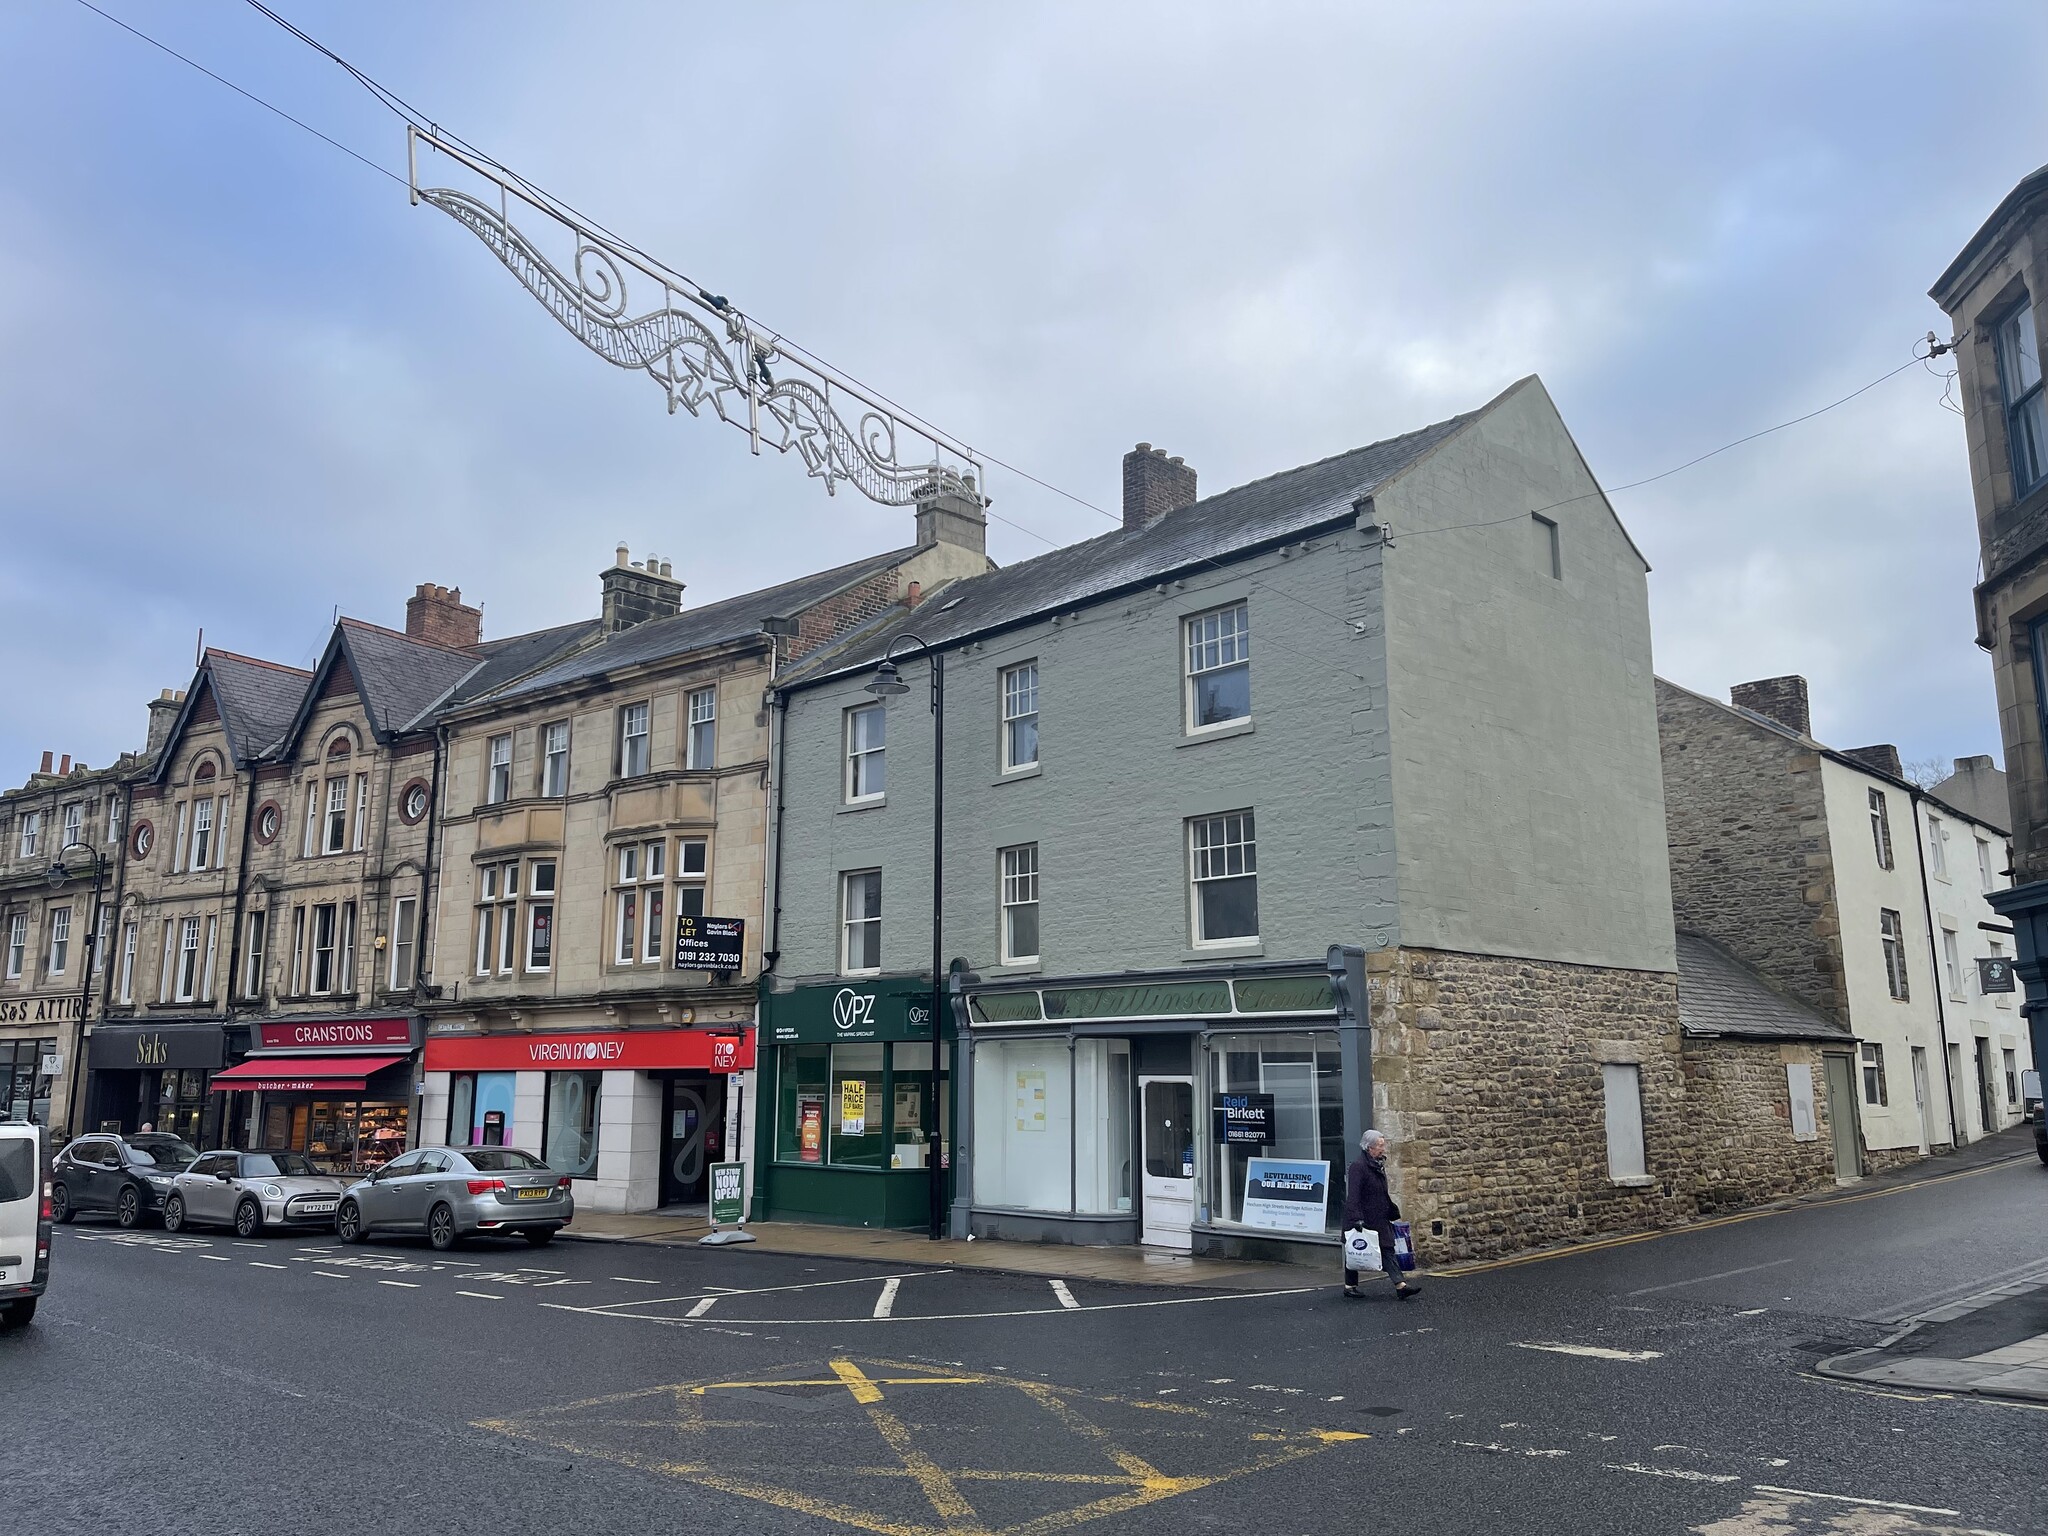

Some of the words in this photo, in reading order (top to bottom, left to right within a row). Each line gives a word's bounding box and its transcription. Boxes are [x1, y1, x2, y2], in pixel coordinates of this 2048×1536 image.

[681, 918, 693, 926] TO
[681, 928, 697, 936] LET
[679, 938, 709, 948] Offices
[678, 951, 696, 961] 0191
[699, 952, 716, 962] 232
[718, 953, 740, 963] 7030
[35, 998, 93, 1020] ATTIRE
[833, 988, 876, 1029] VPZ
[909, 1007, 929, 1023] VPZ
[295, 1025, 373, 1042] CRANSTONS
[136, 1033, 168, 1064] Saks
[529, 1043, 572, 1061] VIRGIN
[573, 1041, 625, 1060] MONEY
[714, 1055, 737, 1067] NEY
[844, 1084, 864, 1094] HALF
[843, 1094, 864, 1103] PRICE
[1224, 1096, 1248, 1107] Reid
[1228, 1108, 1265, 1119] Birkett
[1245, 1131, 1266, 1139] 820771
[716, 1175, 740, 1188] NOW
[1264, 1172, 1312, 1181] REVITALISING
[1261, 1180, 1276, 1188] OUR
[714, 1187, 741, 1200] OPEN!
